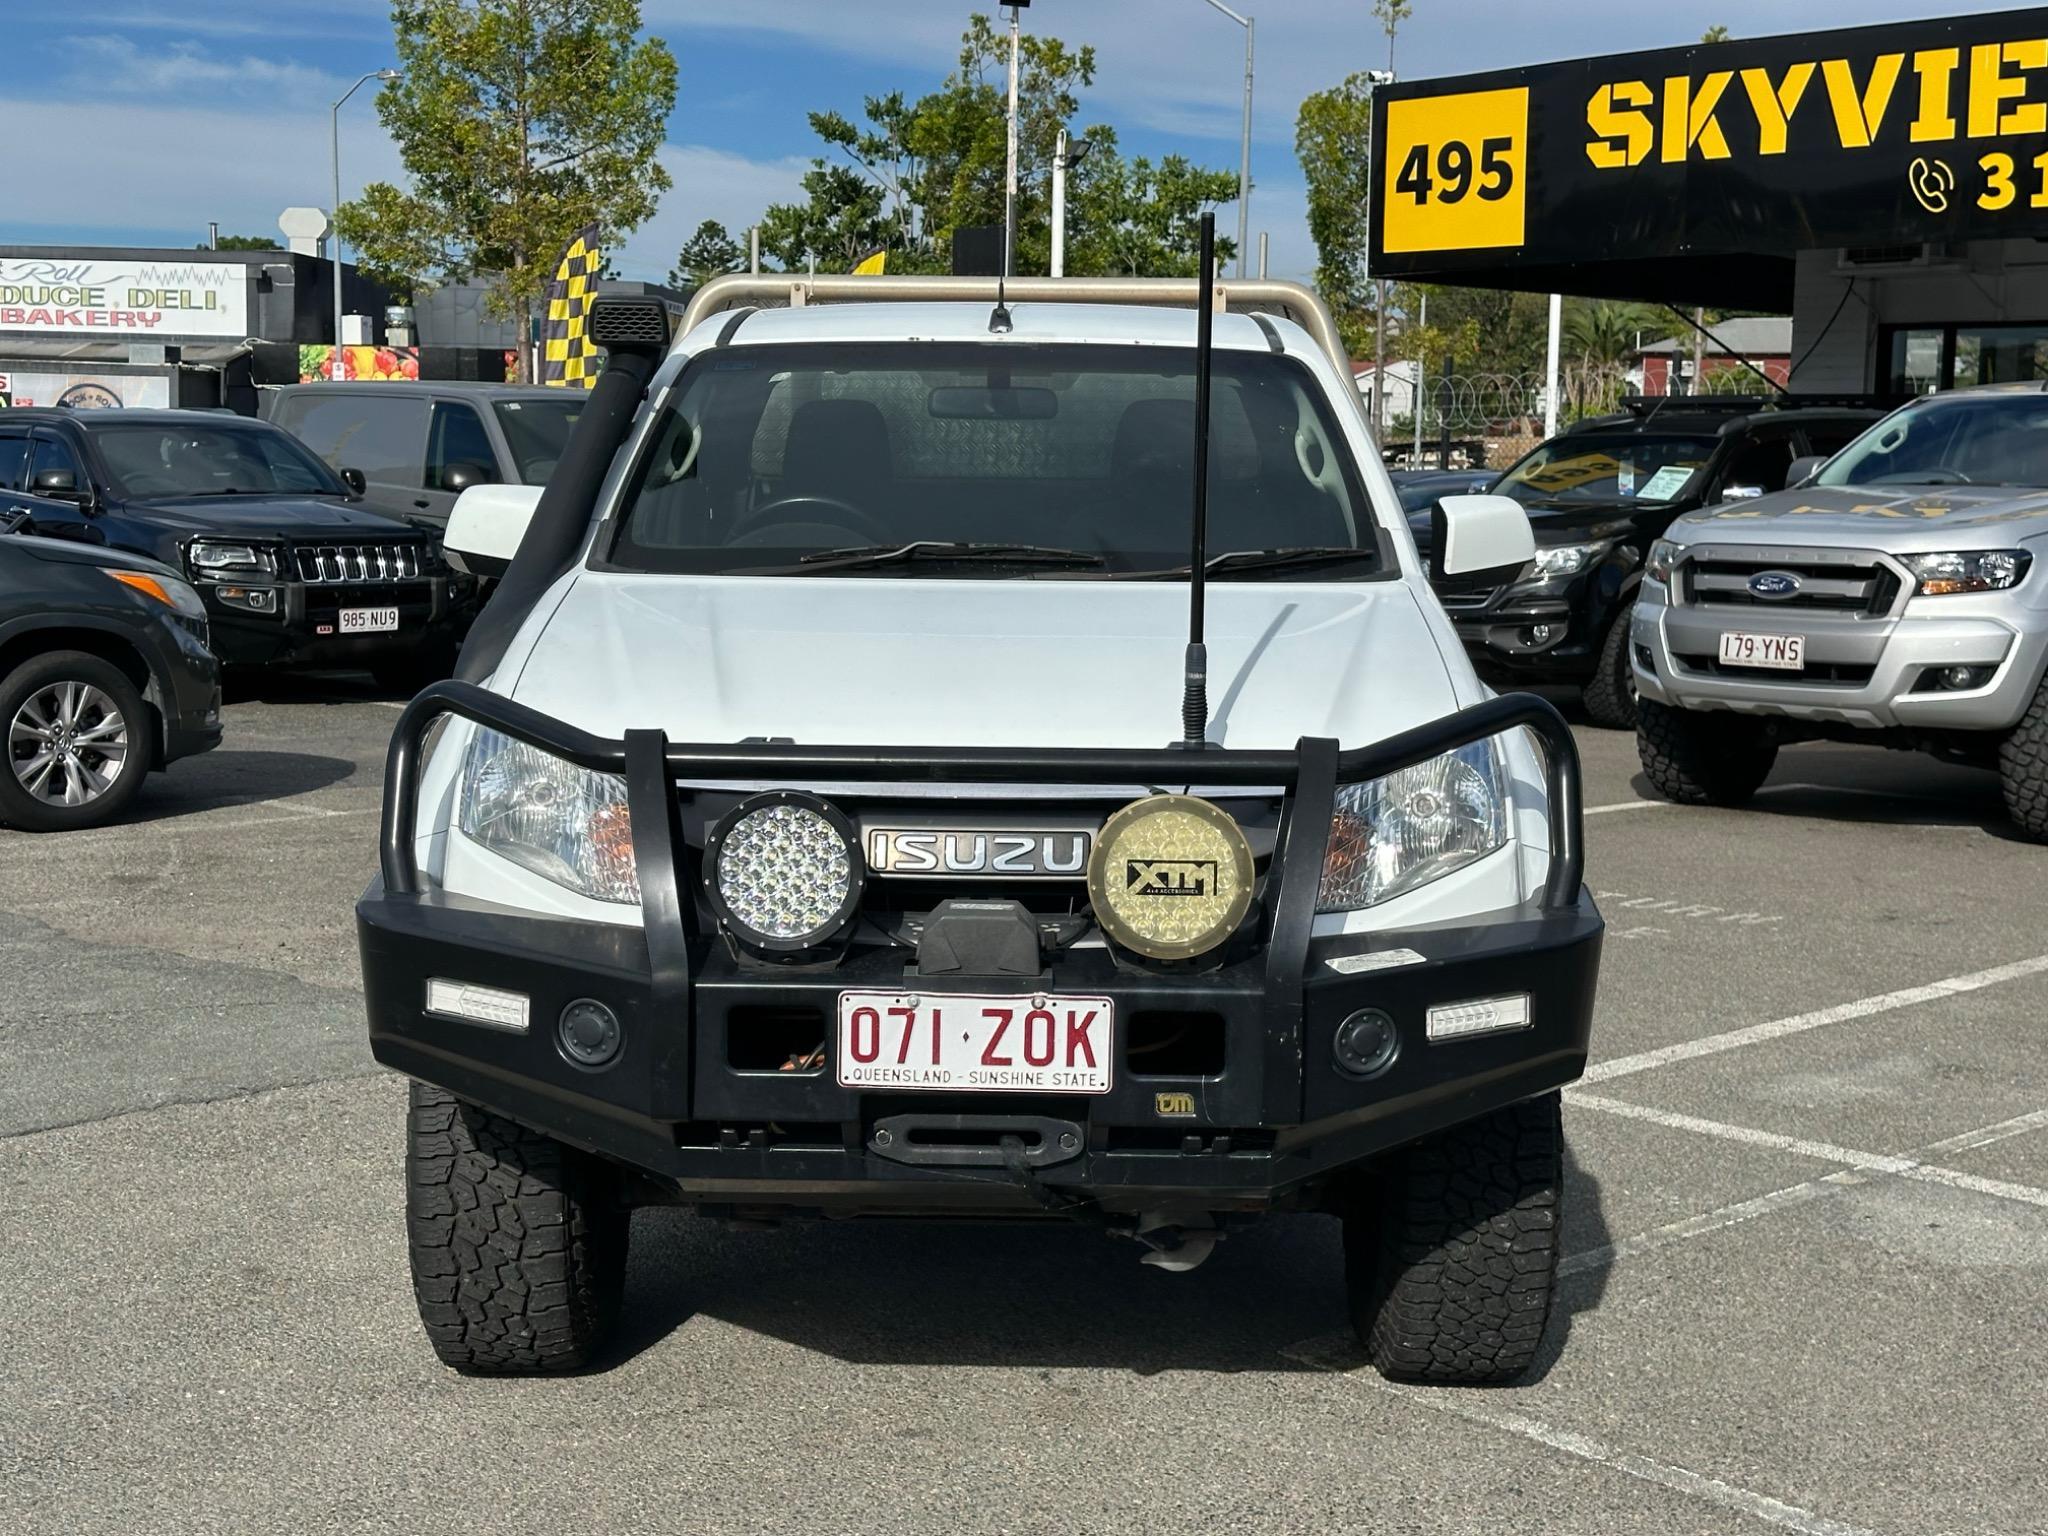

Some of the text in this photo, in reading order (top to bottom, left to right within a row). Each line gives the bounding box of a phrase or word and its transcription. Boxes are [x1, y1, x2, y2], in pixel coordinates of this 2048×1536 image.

[1586, 39, 2048, 168] SKYVIE
[1396, 137, 1514, 206] 495
[11, 262, 96, 286] Roll
[1, 308, 162, 328] BAKERY
[343, 610, 396, 627] 985 NU9
[1724, 636, 1799, 661] 179 YNS
[874, 833, 1085, 872] ISUZU
[1127, 862, 1214, 896] XTM
[850, 1006, 1098, 1068] 071 ZOK
[853, 1068, 951, 1083] QUEENSLAND
[969, 1071, 1044, 1086] SUNSHINE
[1052, 1072, 1097, 1087] STATE
